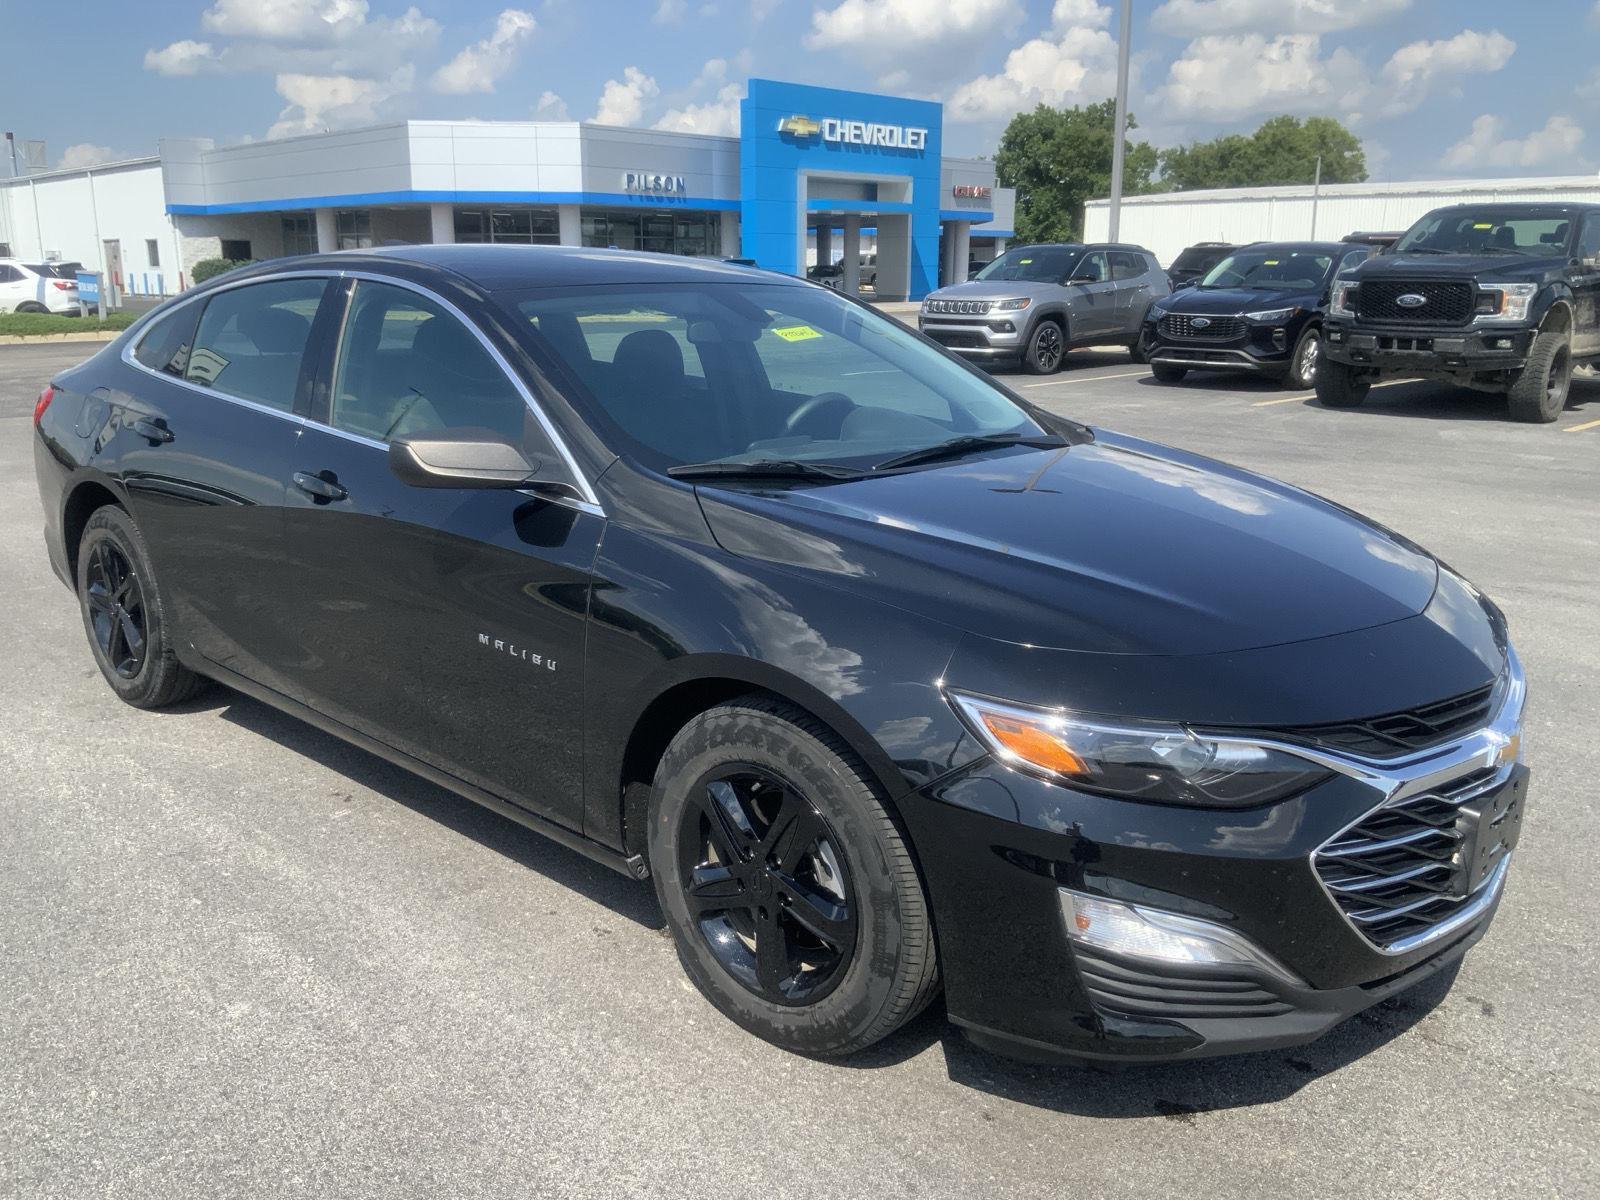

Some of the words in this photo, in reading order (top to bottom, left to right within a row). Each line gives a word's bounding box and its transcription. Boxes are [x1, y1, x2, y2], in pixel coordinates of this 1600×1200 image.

[822, 118, 928, 150] CHEVROLET
[625, 173, 686, 193] PILSON
[478, 633, 557, 671] MALIBU
